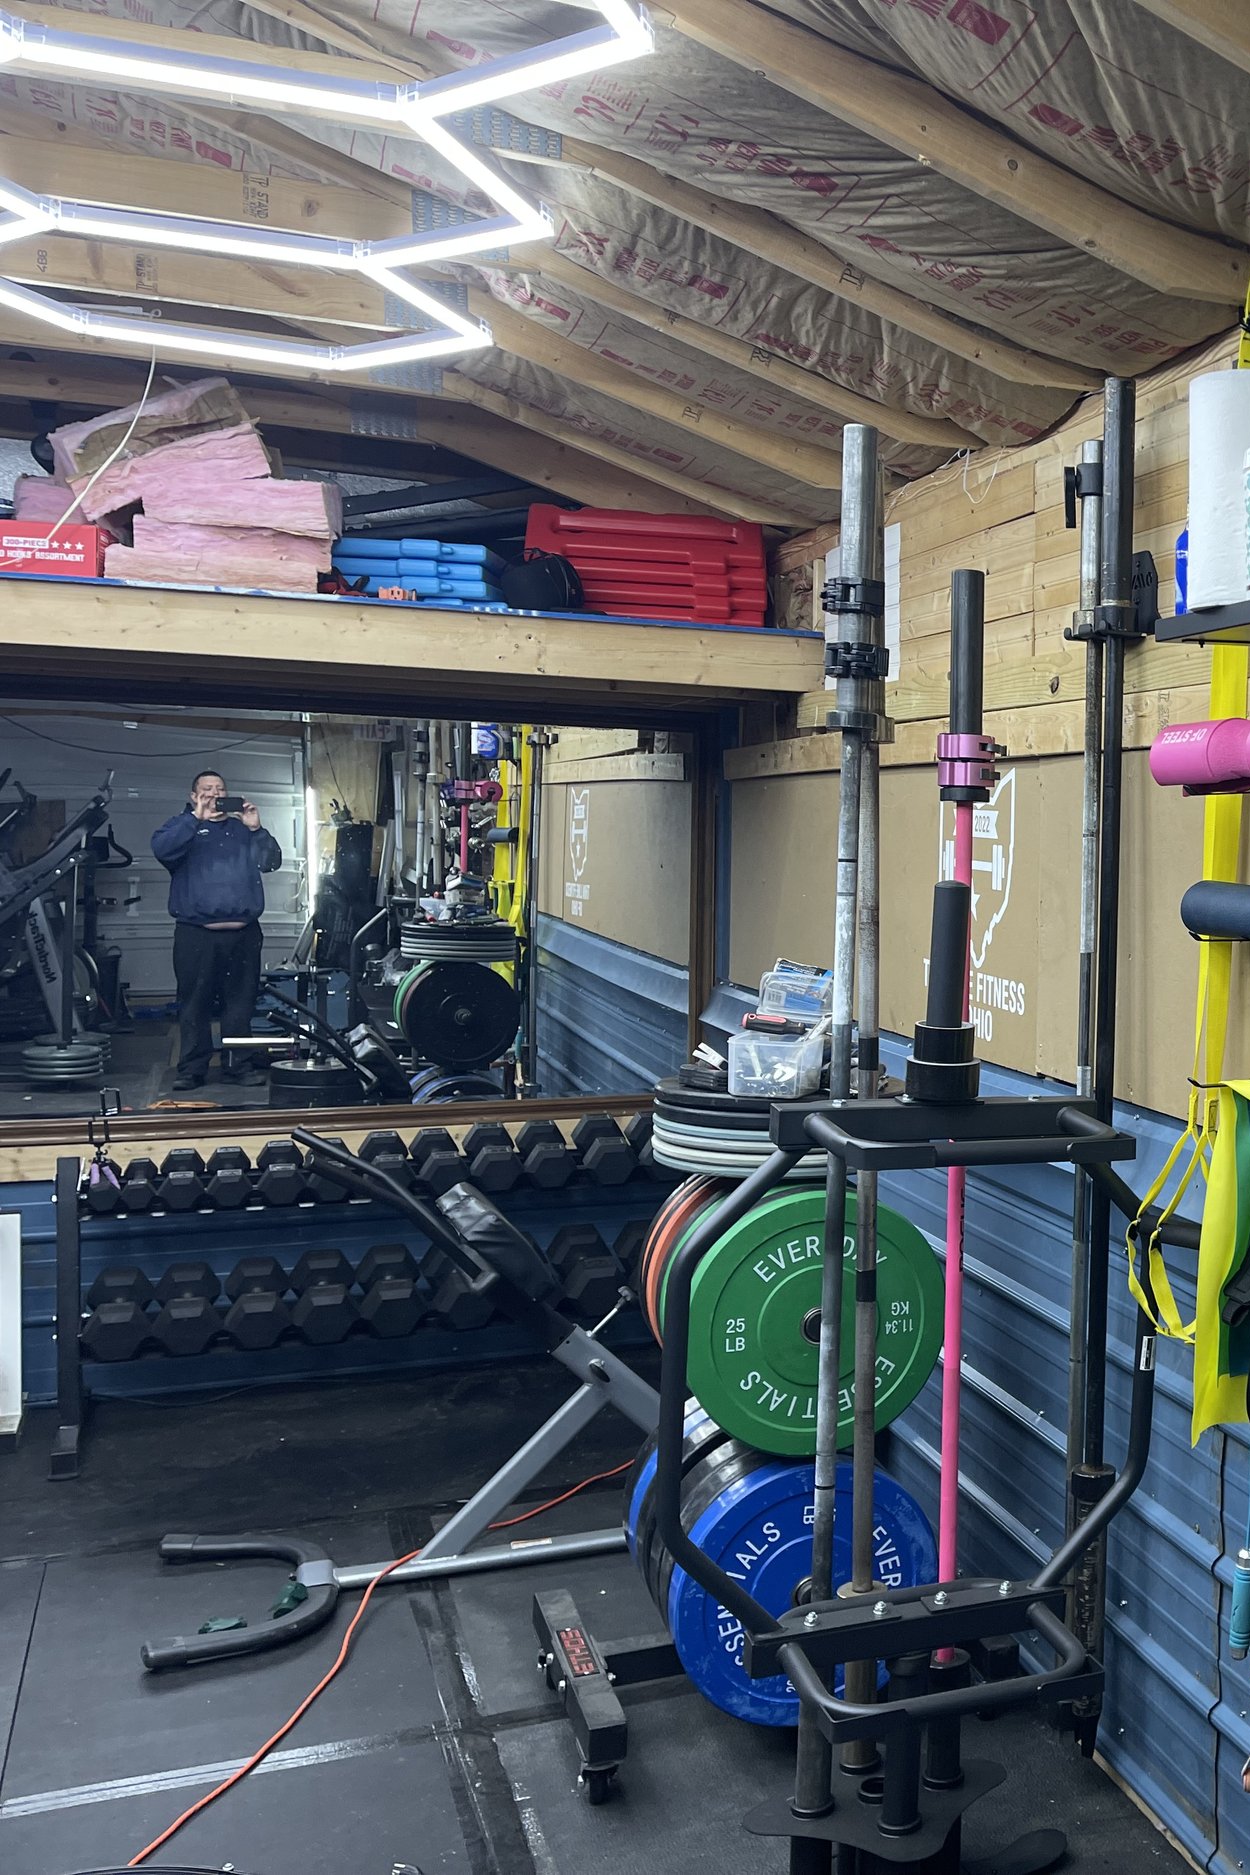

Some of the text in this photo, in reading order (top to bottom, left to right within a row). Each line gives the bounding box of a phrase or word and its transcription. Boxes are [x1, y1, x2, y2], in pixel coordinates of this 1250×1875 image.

[35, 551, 84, 562] ASSORTMENT
[1161, 730, 1191, 744] STEEL
[1190, 728, 1207, 742] OF
[974, 815, 990, 833] 2022
[976, 972, 1025, 1016] FITNESS
[891, 1301, 909, 1316] KG
[726, 1318, 745, 1333] 25
[885, 1318, 913, 1335] 11.34
[725, 1337, 745, 1352] LB
[559, 1629, 596, 1674] ETHOS
